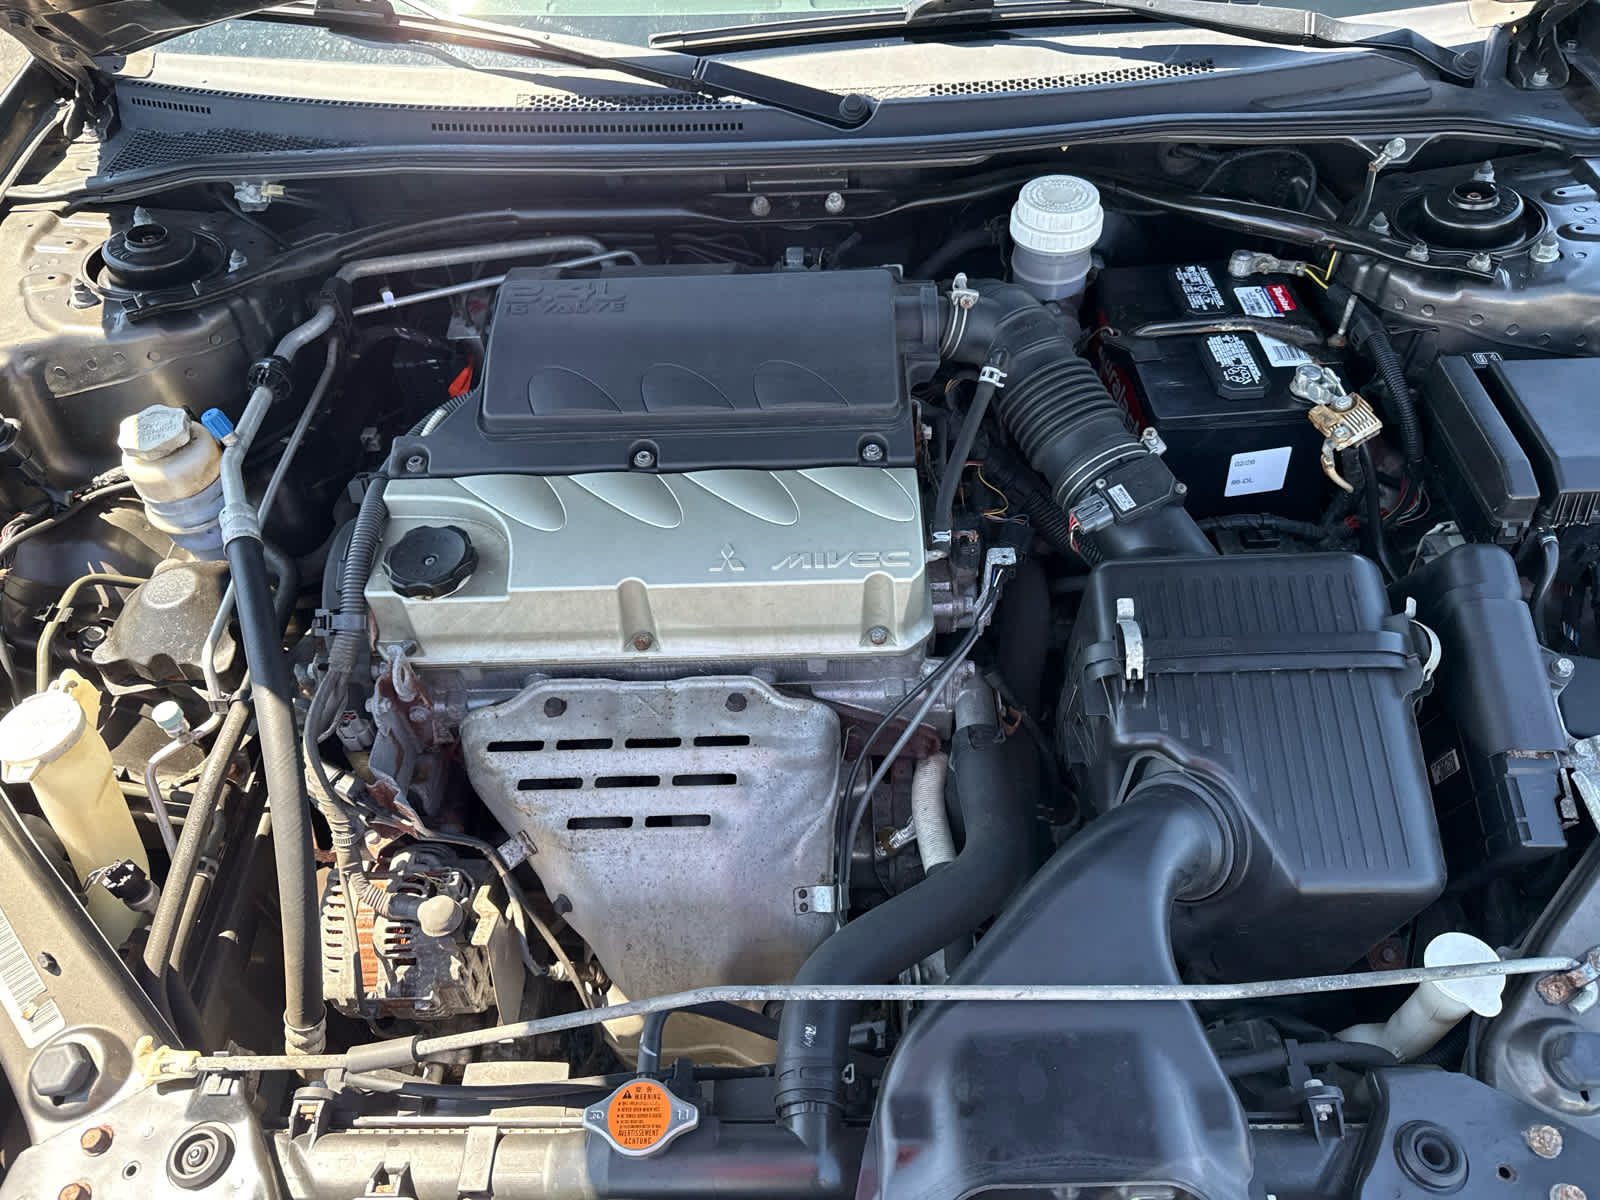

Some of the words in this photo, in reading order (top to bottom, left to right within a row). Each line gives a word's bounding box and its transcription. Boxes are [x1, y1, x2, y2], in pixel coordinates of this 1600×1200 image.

[536, 301, 626, 314] VALVE
[771, 551, 911, 570] MIVEC
[617, 1129, 660, 1137] AVERTISSEMENT
[624, 1137, 652, 1145] ACHTUNG
